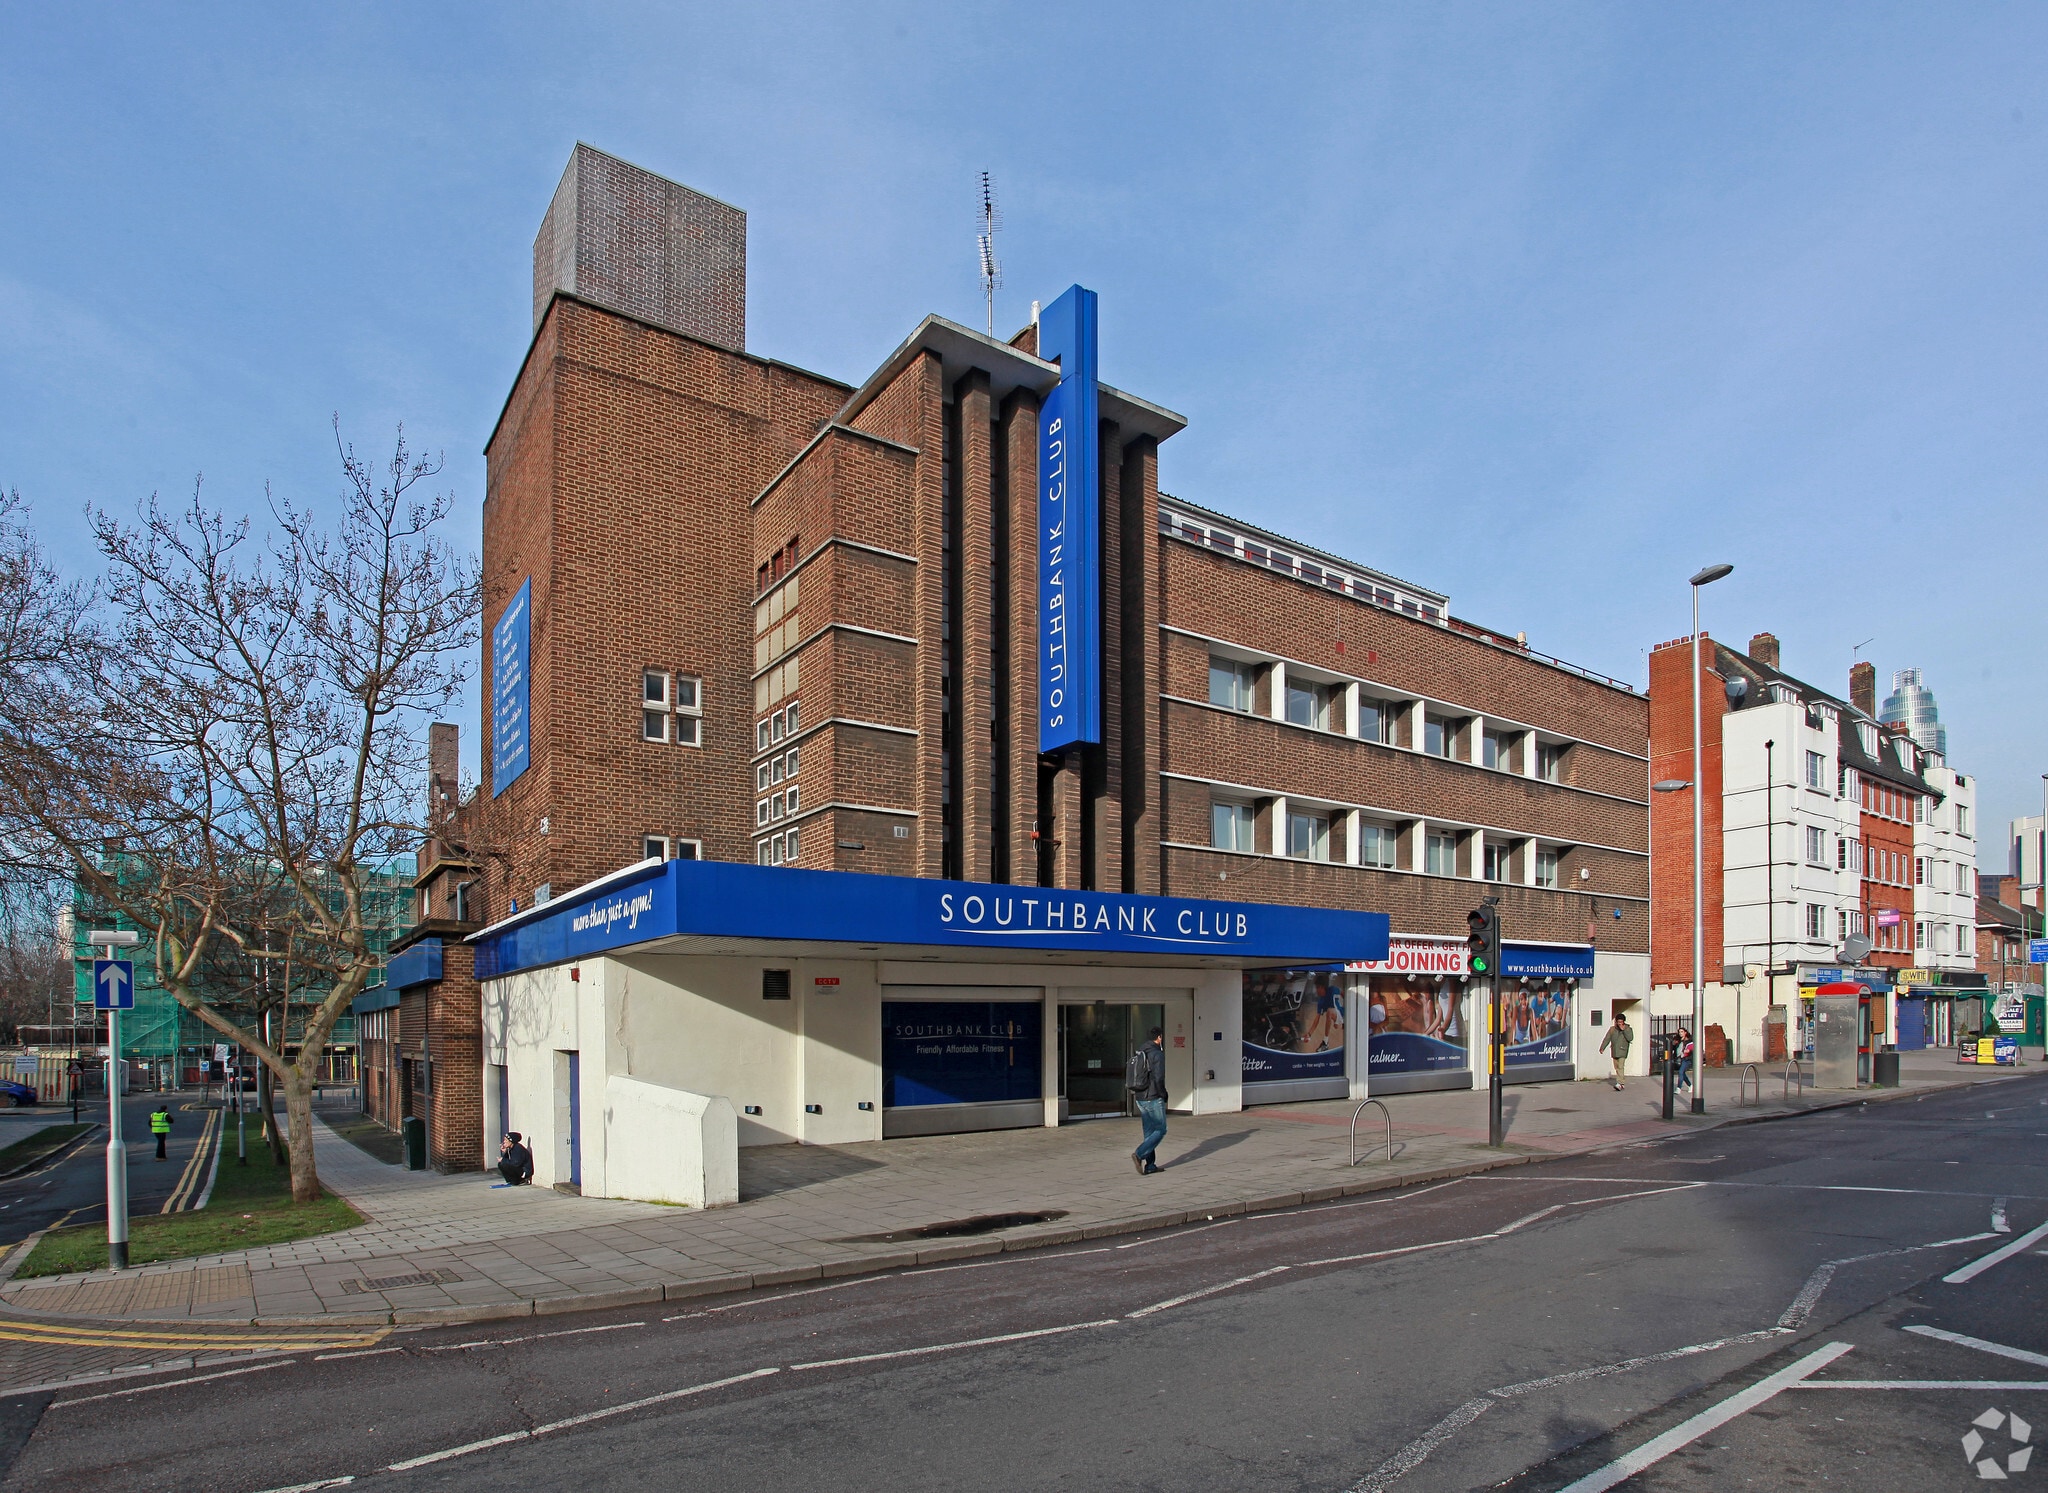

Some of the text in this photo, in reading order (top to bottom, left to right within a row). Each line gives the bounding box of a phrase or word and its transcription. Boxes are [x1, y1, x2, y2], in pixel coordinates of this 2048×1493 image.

[1049, 417, 1063, 728] SOUTHBANK CLUB
[573, 888, 653, 934] more than just a gym!
[940, 893, 1247, 938] SOUTHBANK CLUB
[1404, 940, 1434, 951] OFFER
[1442, 942, 1460, 952] GET
[1462, 942, 1471, 952] F
[1384, 951, 1461, 971] JOINING
[1507, 964, 1593, 974] www.southbankclub.co.uk
[896, 1025, 1022, 1036] SOUTHBANK CLUB
[916, 1043, 1005, 1055] Friendly Affordable Fitness
[1370, 1049, 1405, 1063] calmer...
